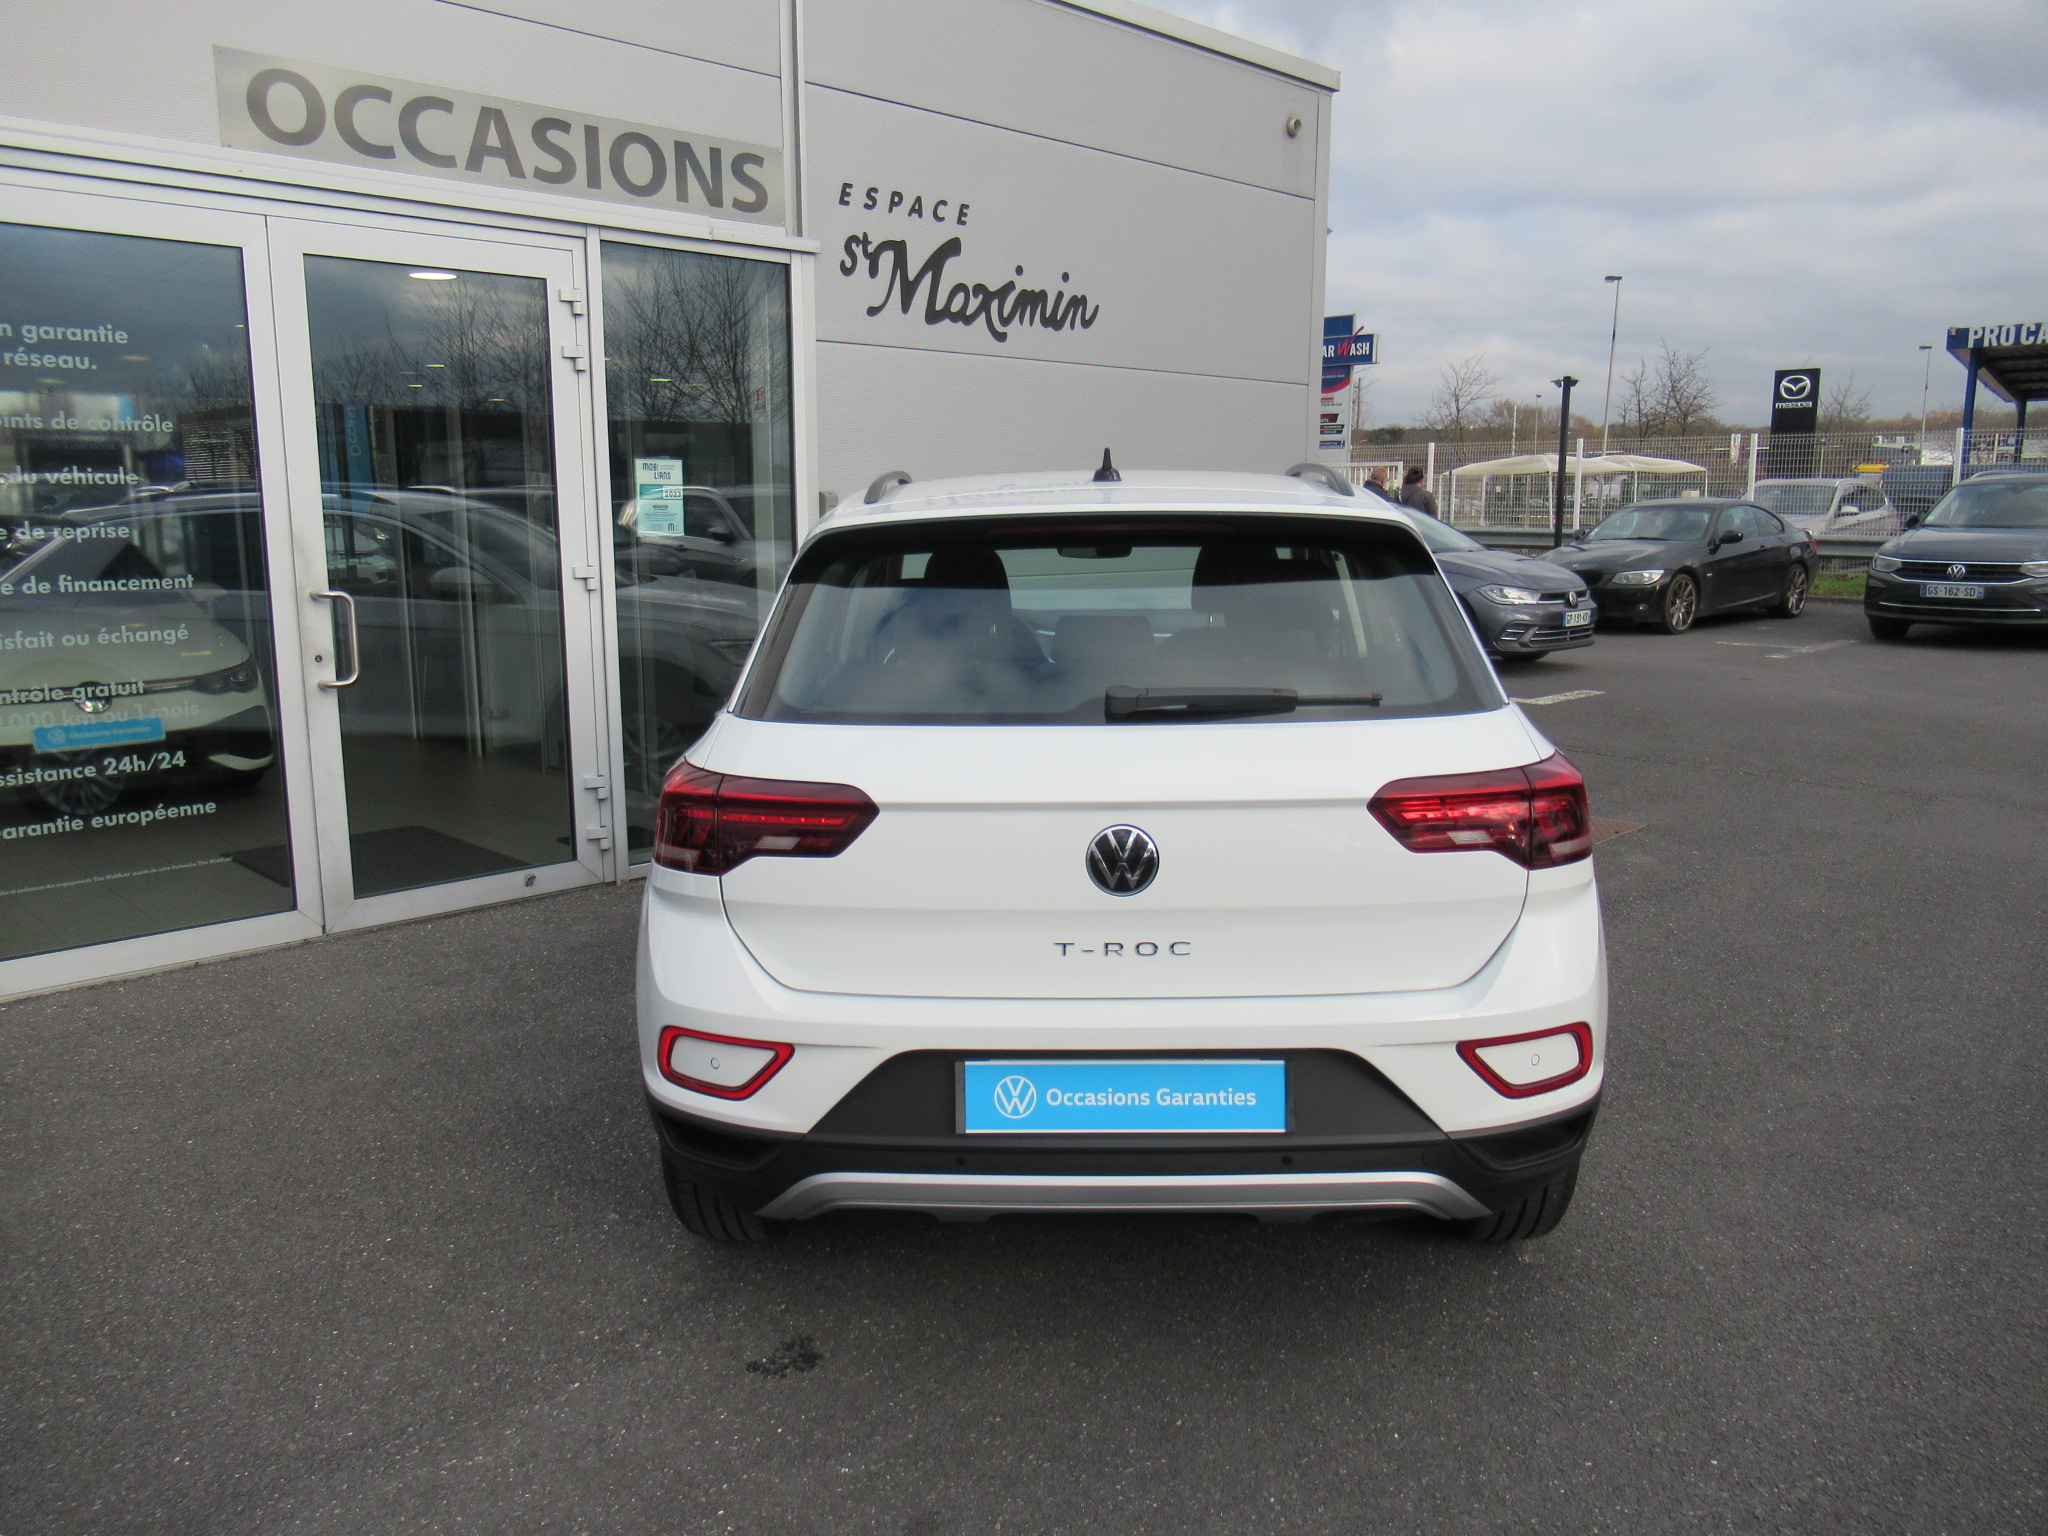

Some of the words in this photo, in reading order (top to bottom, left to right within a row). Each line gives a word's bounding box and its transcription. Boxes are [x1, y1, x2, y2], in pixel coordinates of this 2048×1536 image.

[246, 68, 768, 214] OCCASIONS
[838, 182, 970, 226] ESPACE
[866, 236, 1100, 343] Maximin
[21, 323, 129, 344] garantie
[1337, 332, 1370, 357] WASH
[1967, 324, 2016, 349] PRO
[3, 346, 97, 370] réseau.
[1775, 401, 1812, 409] mazda
[0, 412, 44, 429] ints
[51, 410, 80, 430] de
[87, 413, 174, 432] contrôle
[11, 464, 38, 485] du
[45, 466, 139, 485] véhicule
[664, 490, 682, 498] 2023
[15, 520, 46, 540] de
[53, 521, 131, 543] reprise
[22, 575, 51, 595] de
[58, 574, 194, 593] financement
[62, 633, 90, 647] ou
[97, 623, 190, 645] échangé
[71, 678, 146, 703] gratuit
[103, 710, 129, 723] ou
[151, 700, 200, 719] mois
[103, 750, 187, 776] 24h/24
[0, 815, 84, 840] arantie
[91, 801, 217, 826] européenne
[1053, 941, 1192, 957] T-ROC
[1046, 1087, 1150, 1107] Occasions
[1156, 1087, 1257, 1107] Garanties
